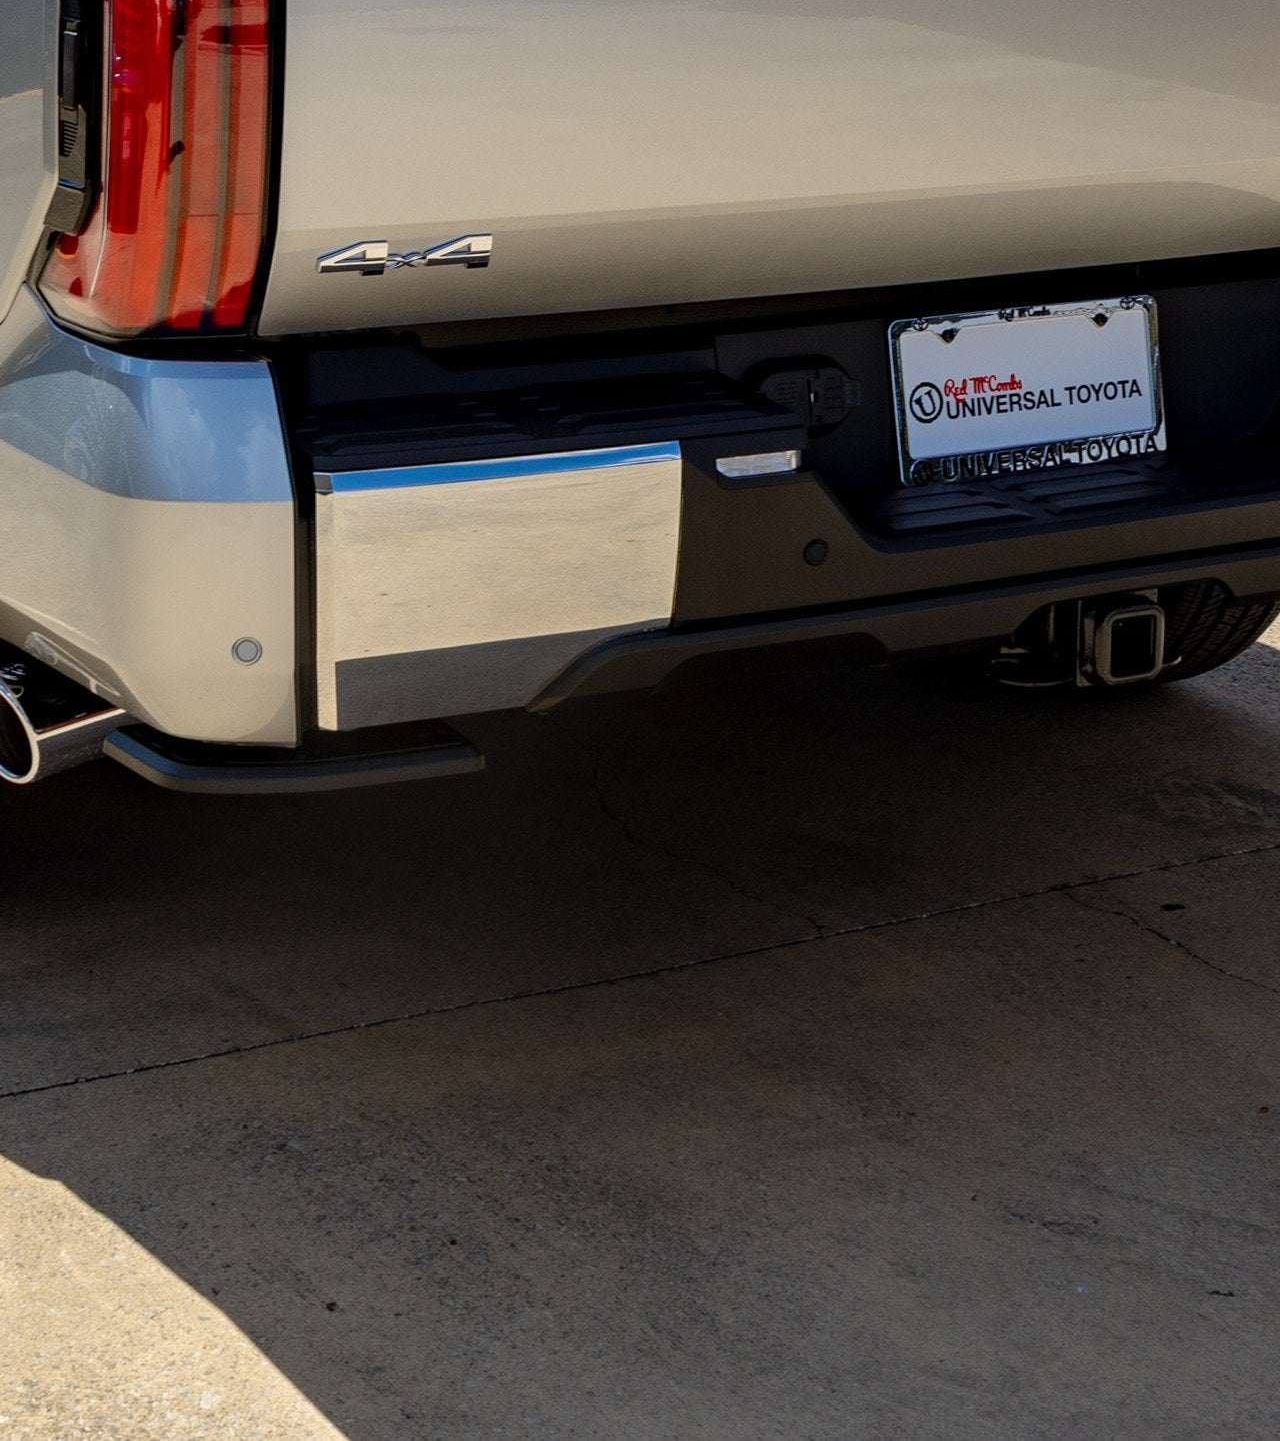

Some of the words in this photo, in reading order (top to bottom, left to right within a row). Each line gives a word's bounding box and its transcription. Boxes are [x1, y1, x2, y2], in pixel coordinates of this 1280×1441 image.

[944, 378, 968, 403] Red
[946, 390, 1062, 420] UNIVERSAL
[1066, 379, 1142, 405] TOYOTA
[940, 440, 1072, 481] UNIVERSAL
[1070, 433, 1158, 464] TOYOTA
